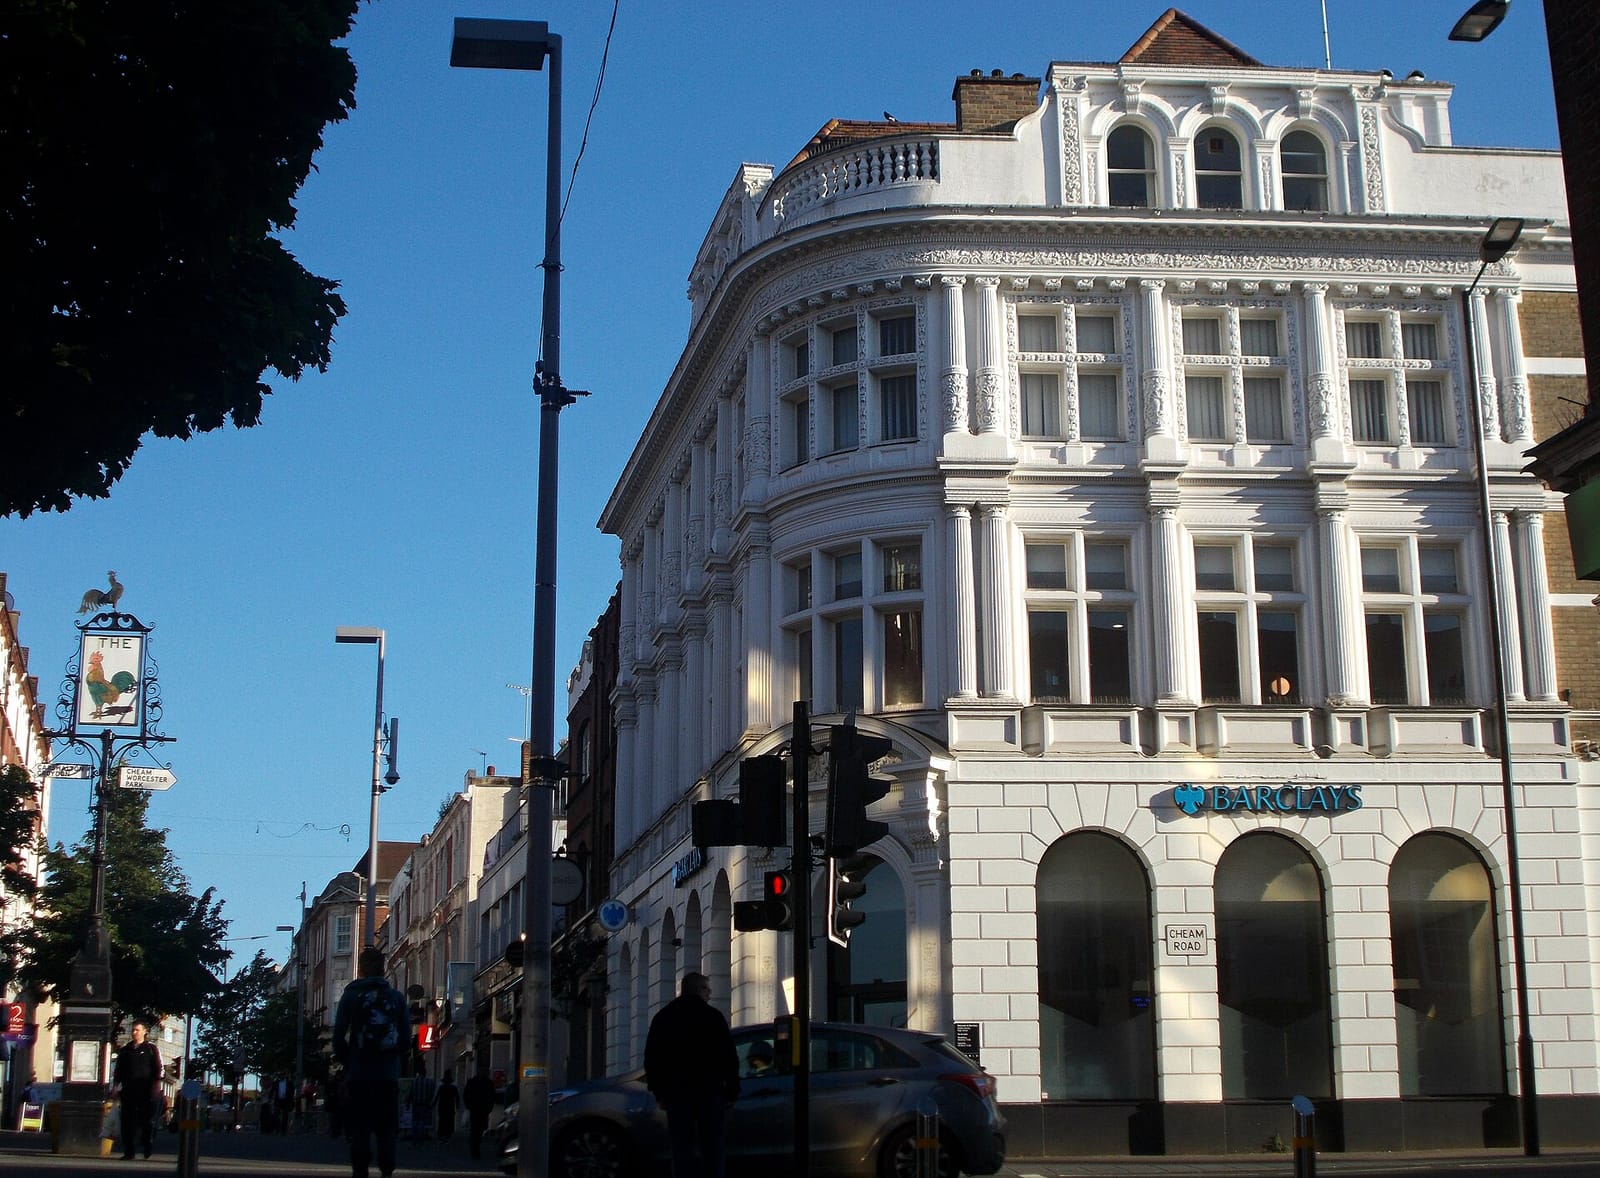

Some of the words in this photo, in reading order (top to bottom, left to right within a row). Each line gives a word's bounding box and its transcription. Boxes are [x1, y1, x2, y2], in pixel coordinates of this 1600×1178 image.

[98, 637, 132, 649] THE
[126, 768, 152, 776] CHEAM
[126, 775, 168, 783] WORCESTER
[1214, 784, 1363, 812] BARCLAYS
[1169, 929, 1205, 939] CHEAM
[1173, 941, 1202, 951] ROAD
